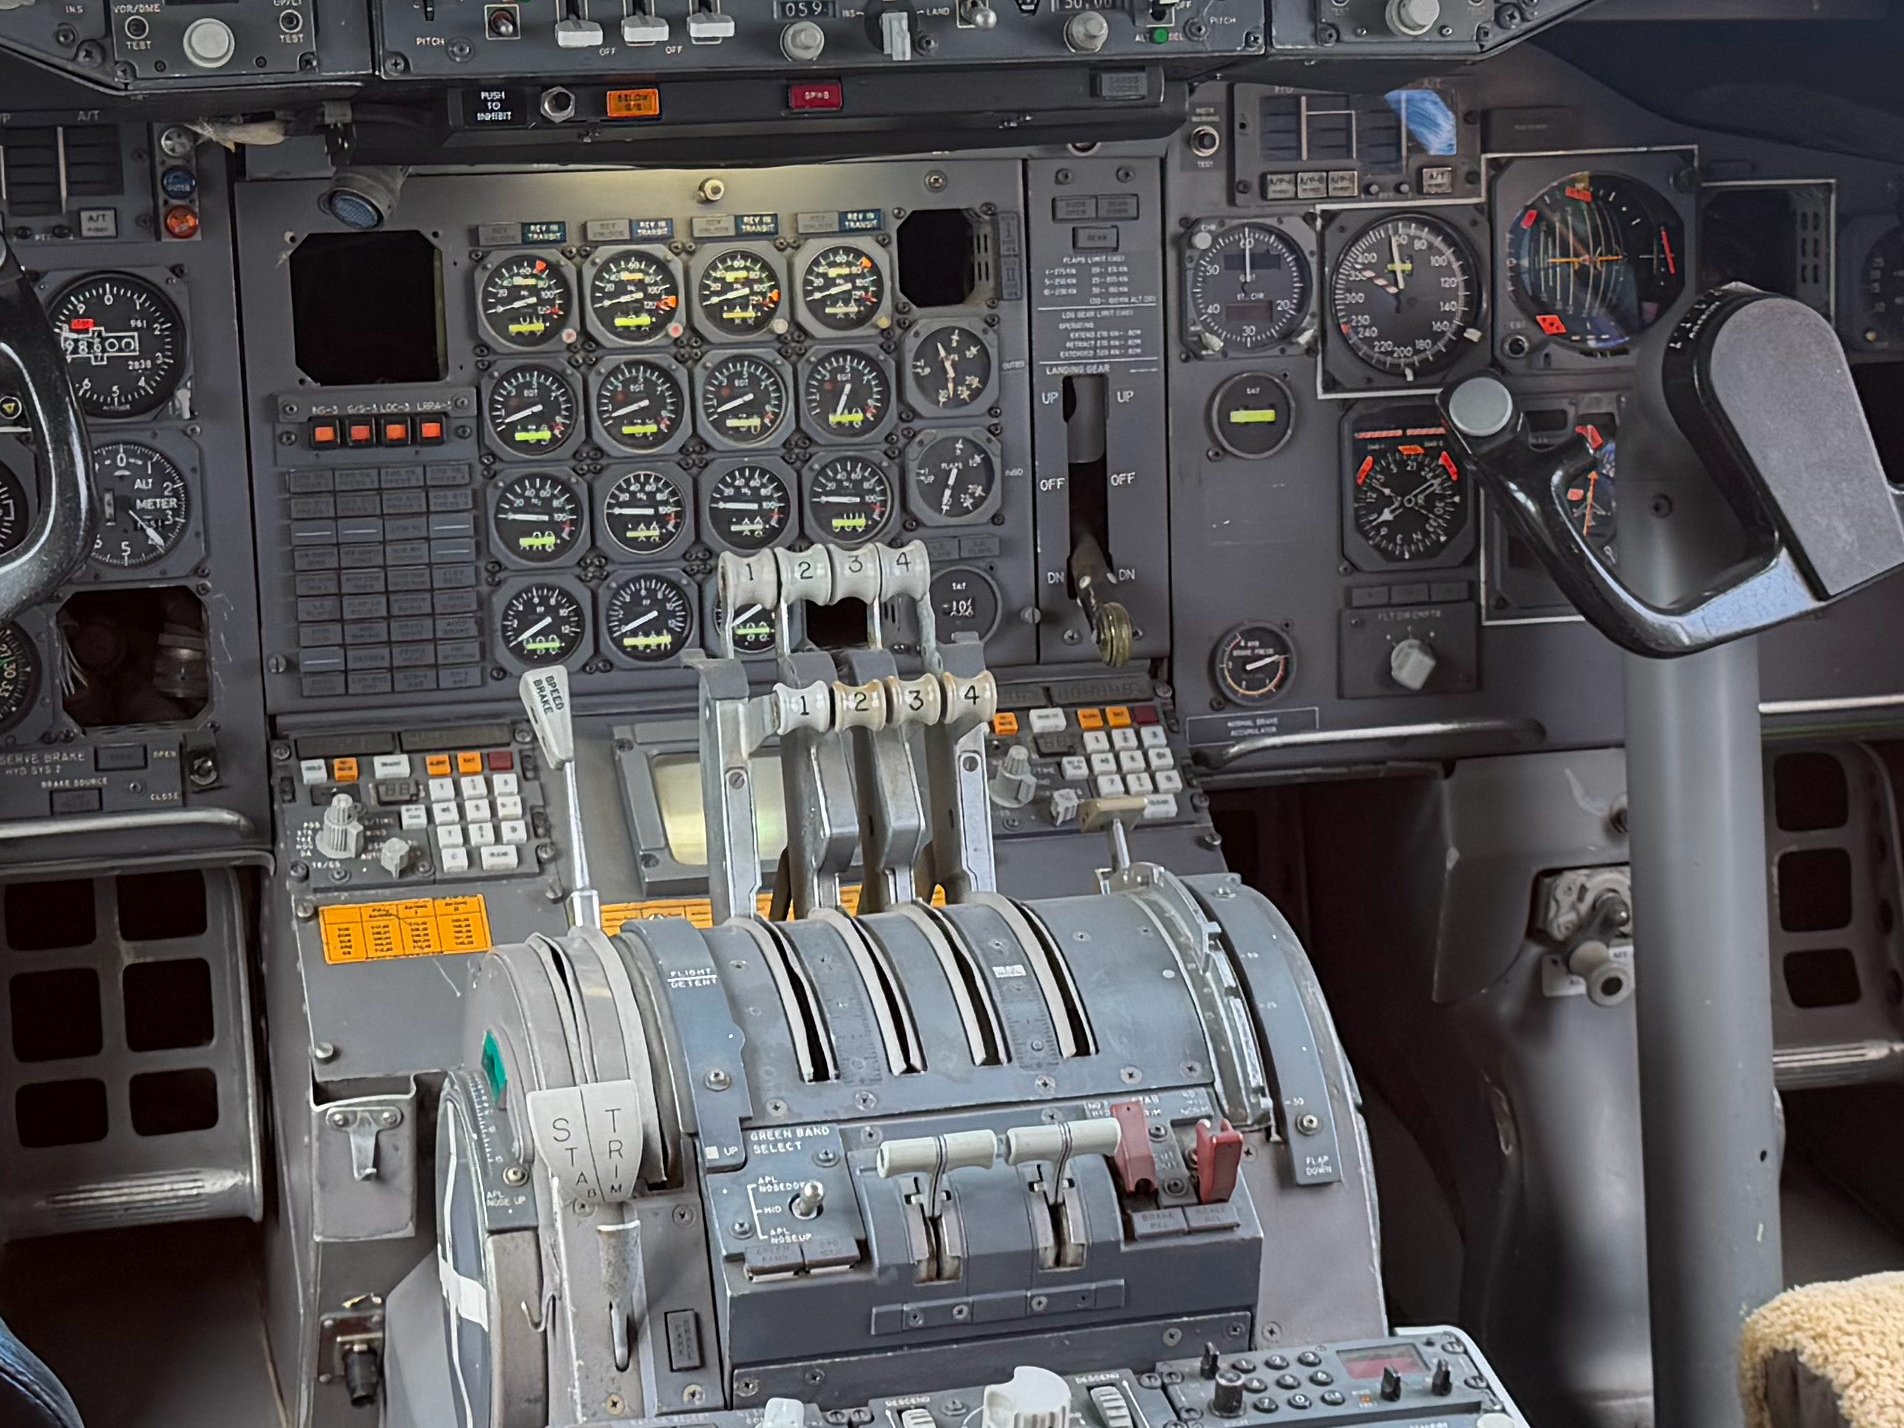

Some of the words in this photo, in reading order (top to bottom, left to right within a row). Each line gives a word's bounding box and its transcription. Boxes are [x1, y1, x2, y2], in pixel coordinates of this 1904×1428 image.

[279, 34, 304, 43] TEST
[416, 38, 444, 46] PITCH
[126, 41, 152, 49] TEST
[77, 111, 100, 121] A/T
[1205, 265, 1219, 276] 50
[1206, 304, 1220, 314] 40
[1277, 301, 1290, 310] 20
[1243, 326, 1256, 336] 30
[1042, 392, 1058, 404] UP
[1117, 391, 1133, 402] UP
[135, 479, 153, 489] ALT
[1040, 478, 1065, 491] OFF
[1111, 472, 1135, 486] OFF
[137, 498, 177, 509] METER
[849, 555, 862, 572] 3
[896, 552, 911, 570] 4
[747, 563, 754, 579] 1
[799, 561, 813, 579] 2
[1119, 569, 1135, 581] DN
[1048, 571, 1064, 583] DN
[533, 680, 554, 715] BRAKE
[545, 675, 565, 710] SPEED
[964, 685, 979, 705] 4
[800, 695, 808, 715] 1
[854, 692, 868, 711] 2
[909, 690, 923, 710] 3
[45, 752, 85, 763] BRAKE
[750, 1129, 791, 1140] GREEN
[724, 1146, 738, 1157] UP
[753, 1141, 802, 1153] SELECT
